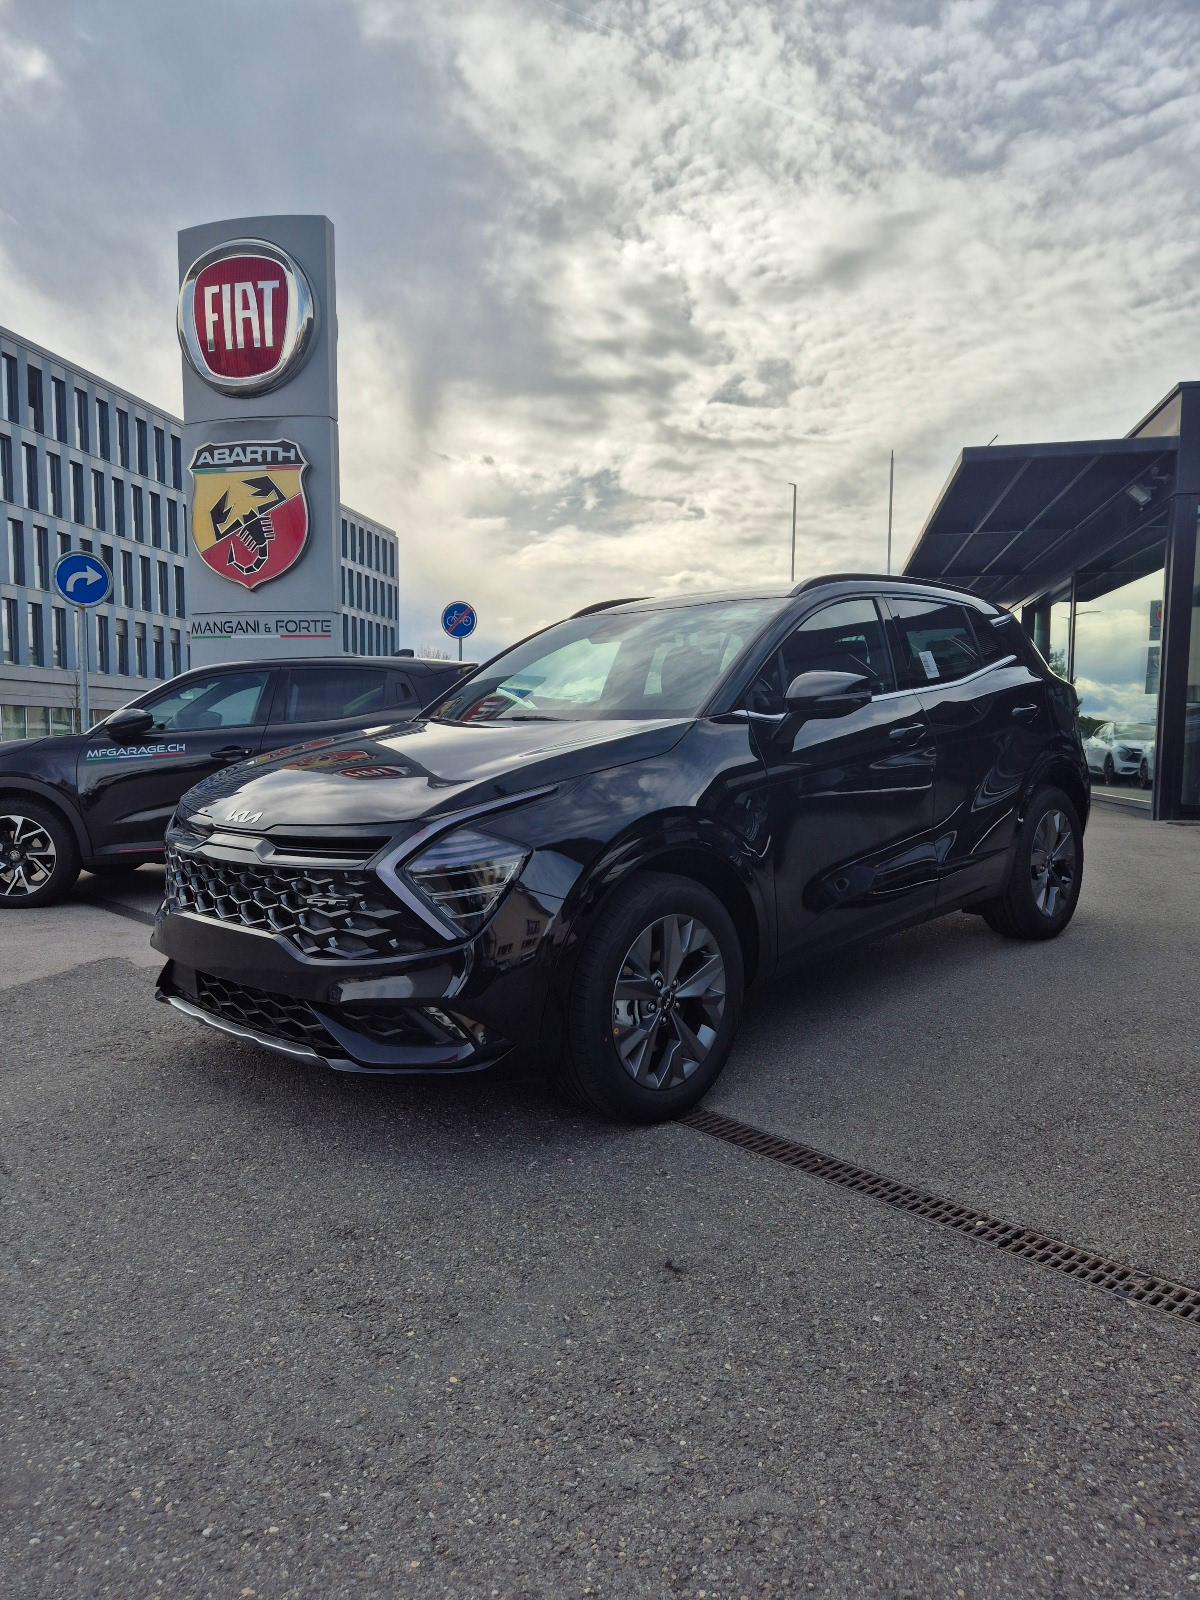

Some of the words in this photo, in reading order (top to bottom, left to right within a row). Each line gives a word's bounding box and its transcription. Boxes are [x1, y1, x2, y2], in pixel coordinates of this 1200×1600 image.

[204, 280, 280, 352] FIAT
[196, 446, 296, 465] ABARTH
[191, 620, 260, 635] MANGANI
[264, 623, 272, 633] &
[275, 620, 332, 633] FORTE
[86, 743, 186, 758] MFGARAGE.CH
[225, 809, 264, 824] KIA
